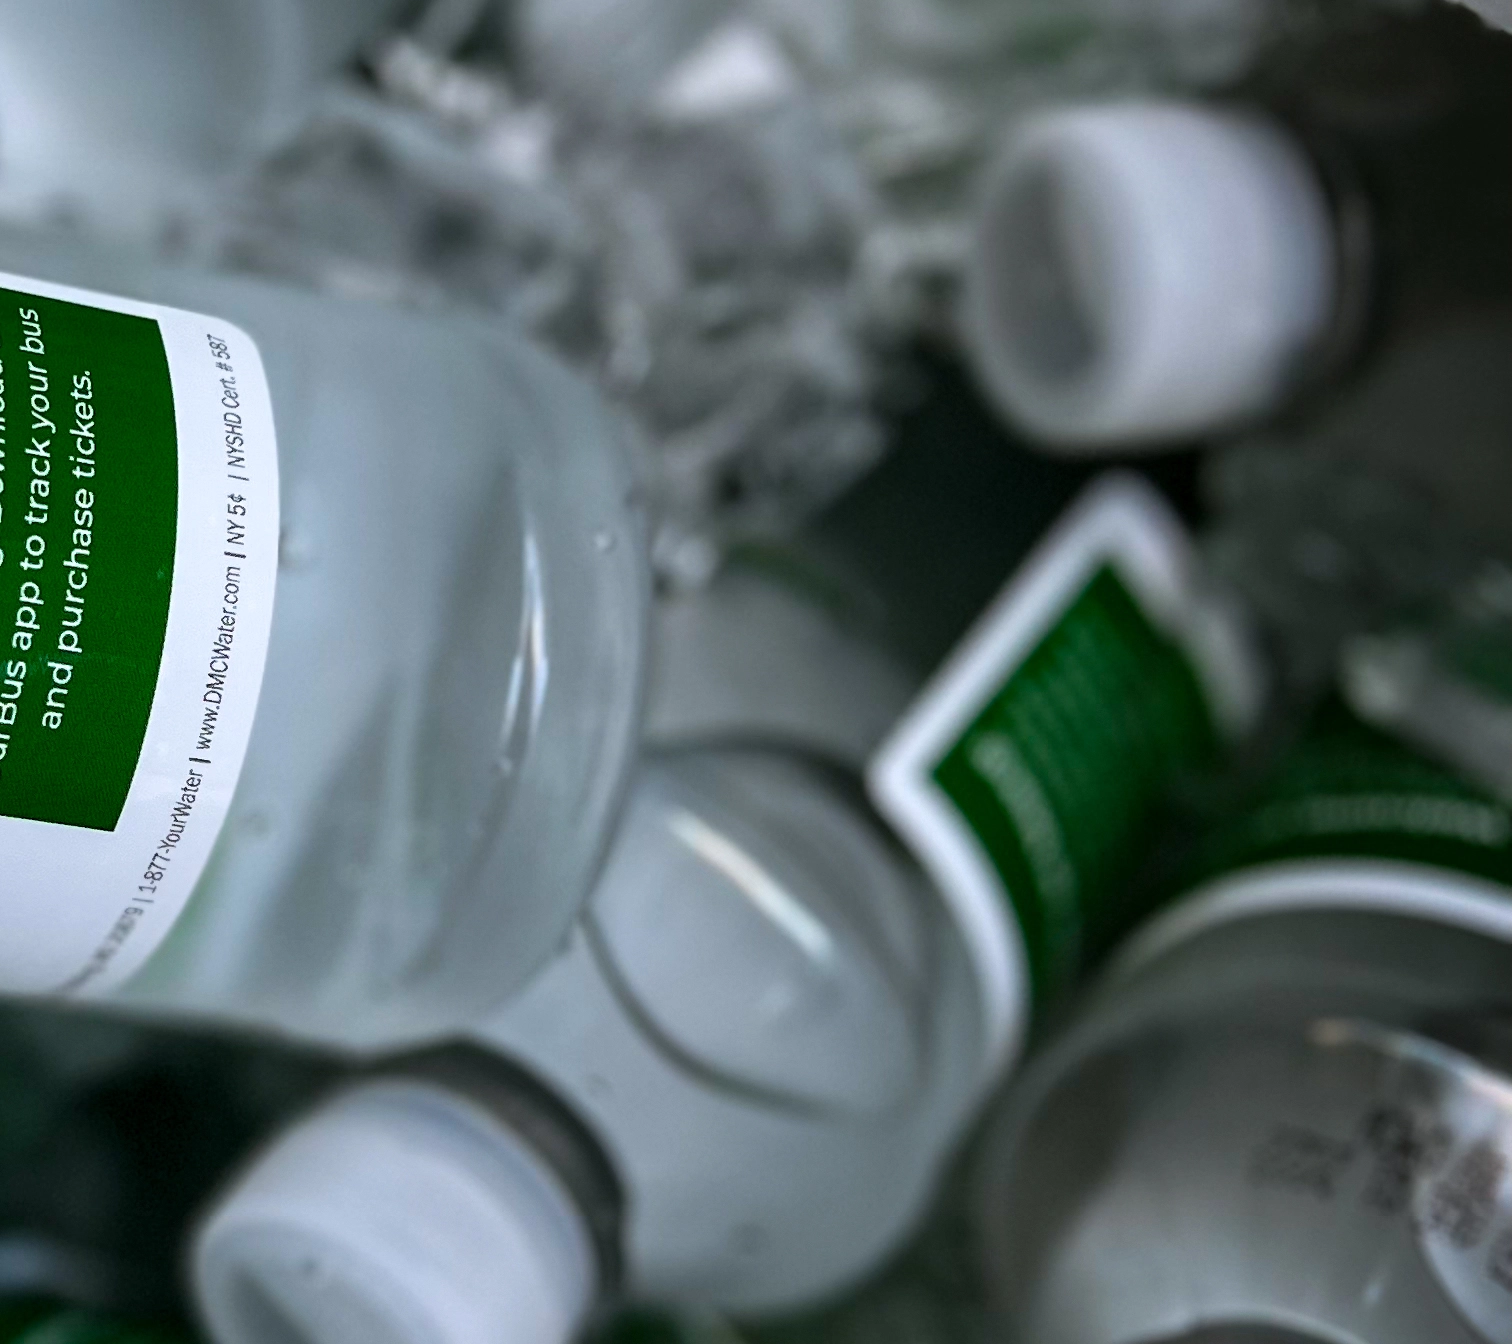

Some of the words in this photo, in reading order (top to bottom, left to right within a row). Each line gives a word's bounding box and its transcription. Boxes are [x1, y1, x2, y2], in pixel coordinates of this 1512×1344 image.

[20, 307, 45, 354] bus
[207, 334, 230, 359] 587
[216, 362, 234, 372] #
[222, 377, 239, 409] Cert.
[29, 362, 56, 435] your
[70, 370, 95, 477] tickets.
[224, 412, 245, 468] NYSHD
[24, 441, 51, 525] track
[228, 493, 245, 516] 5¢
[21, 536, 46, 570] to
[227, 519, 246, 545] NY
[58, 489, 94, 653] purchase
[12, 580, 45, 650] app
[196, 567, 241, 750] www.DMCWater.com
[42, 662, 74, 730] and
[139, 769, 202, 894] 1-877-YourWater
